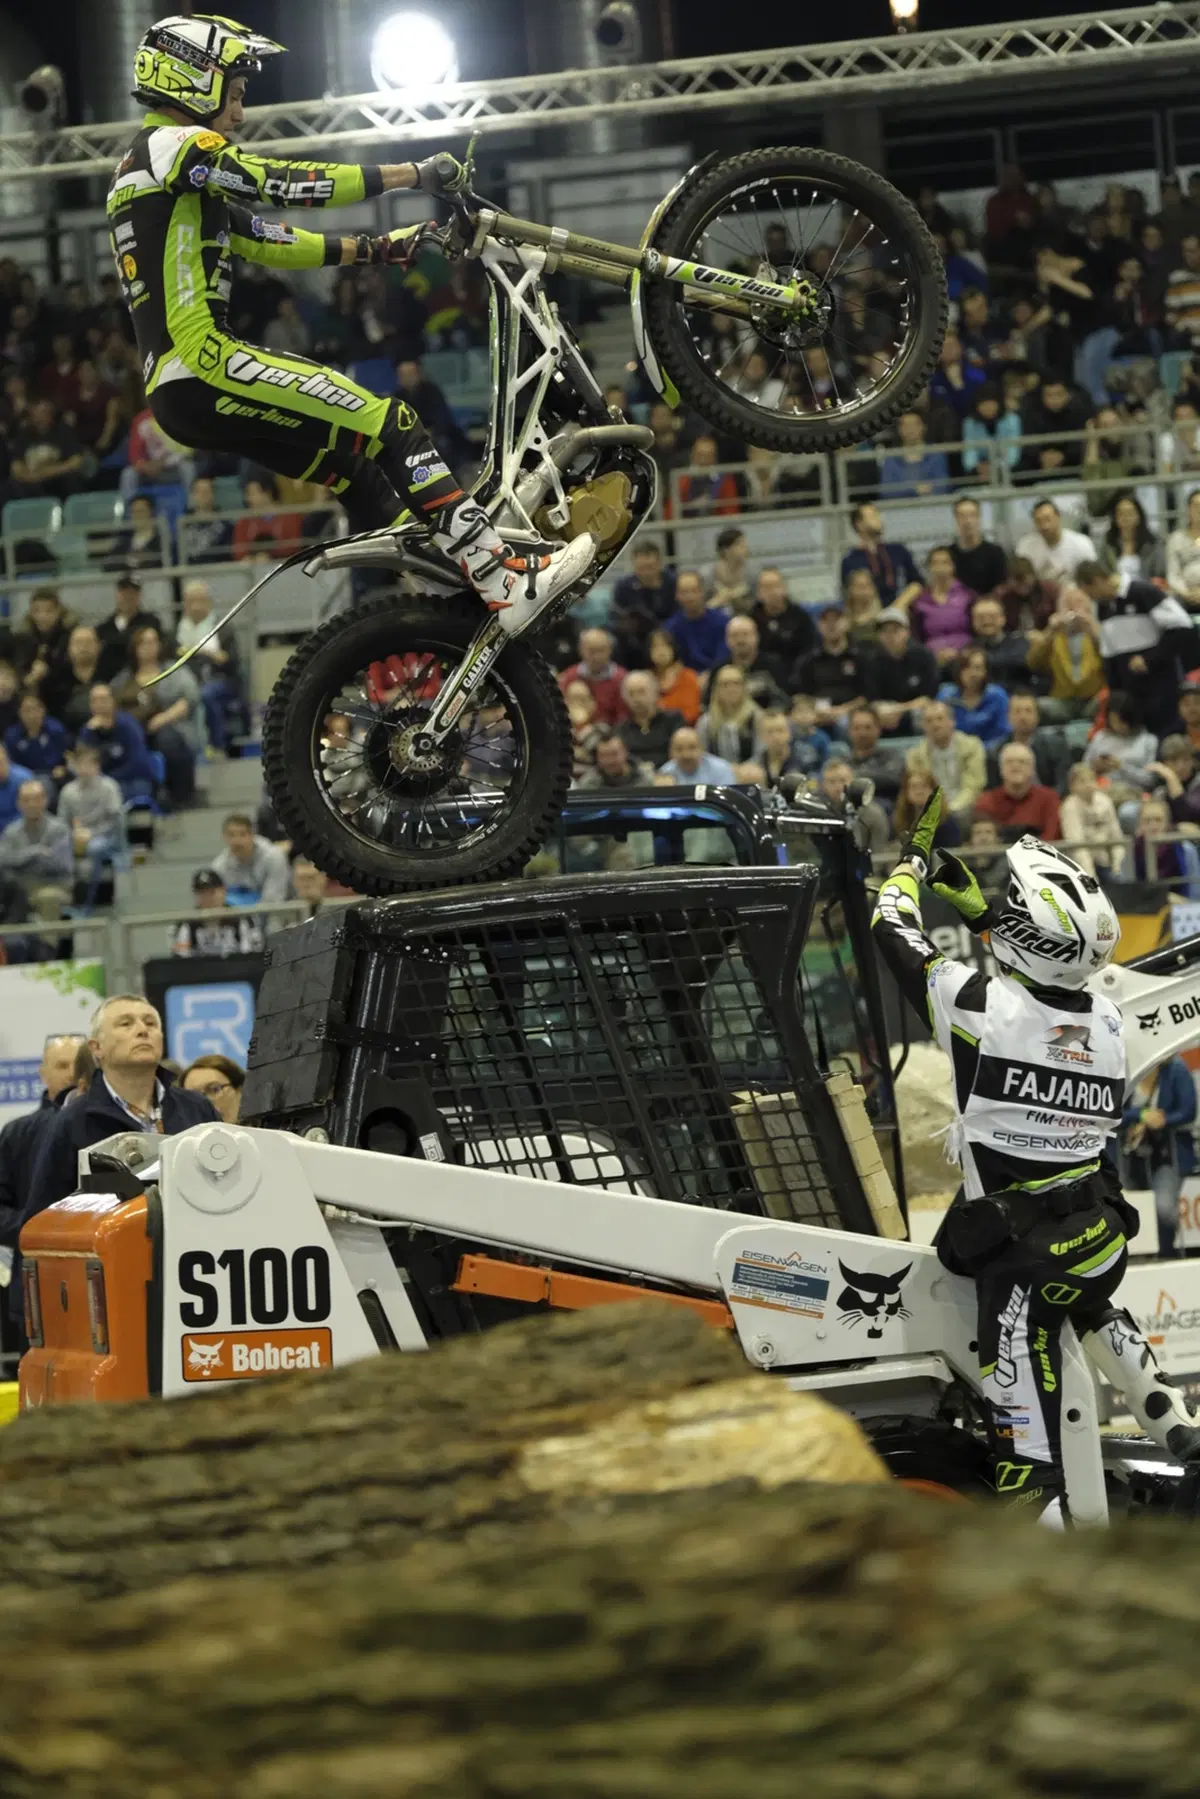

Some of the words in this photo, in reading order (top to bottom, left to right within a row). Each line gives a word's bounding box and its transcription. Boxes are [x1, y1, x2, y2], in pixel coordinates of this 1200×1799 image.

[693, 267, 786, 297] Vertigo
[226, 350, 366, 412] Vertigo
[215, 396, 303, 428] Vertigo
[462, 647, 493, 689] GALFER
[1003, 1067, 1115, 1112] FAJARDO
[741, 1250, 828, 1273] EISENWAGEN
[178, 1245, 331, 1328] S100
[232, 1341, 321, 1372] Bobcat
[994, 1283, 1026, 1388] Vertigo
